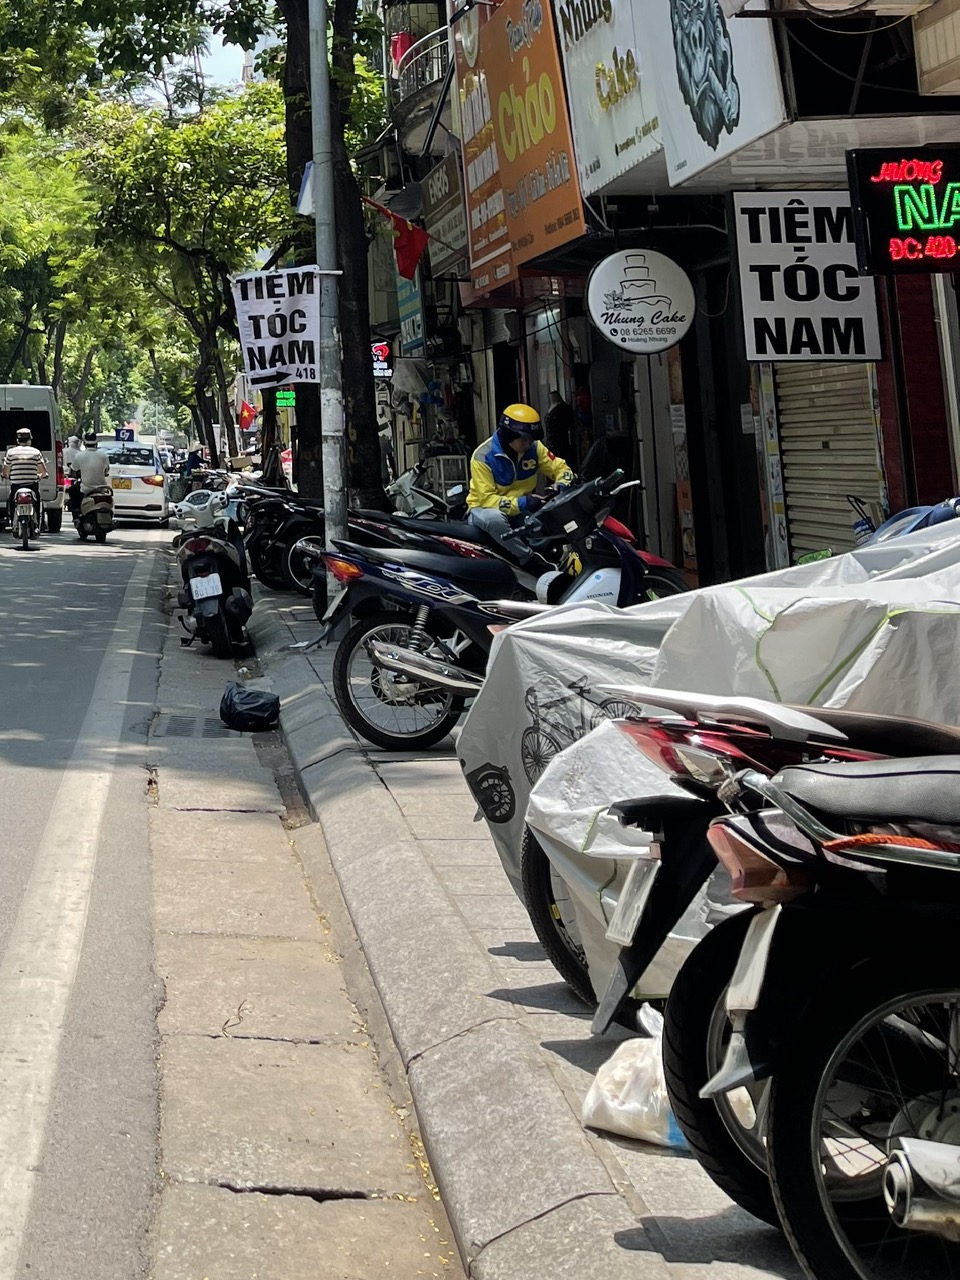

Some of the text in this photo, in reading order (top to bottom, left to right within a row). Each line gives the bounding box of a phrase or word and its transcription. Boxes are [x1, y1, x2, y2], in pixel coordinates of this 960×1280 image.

[595, 45, 638, 111] Cake
[498, 56, 556, 163] Chảo
[427, 165, 450, 206] ENEOS
[740, 198, 856, 253] TIỆM
[749, 256, 860, 302] TÓC
[248, 307, 307, 340] TÓC
[600, 311, 687, 327] Nhung Cake
[620, 327, 677, 336] 08 6265 6699
[753, 317, 866, 355] NAM
[247, 340, 316, 372] NAM
[295, 367, 316, 380] 418
